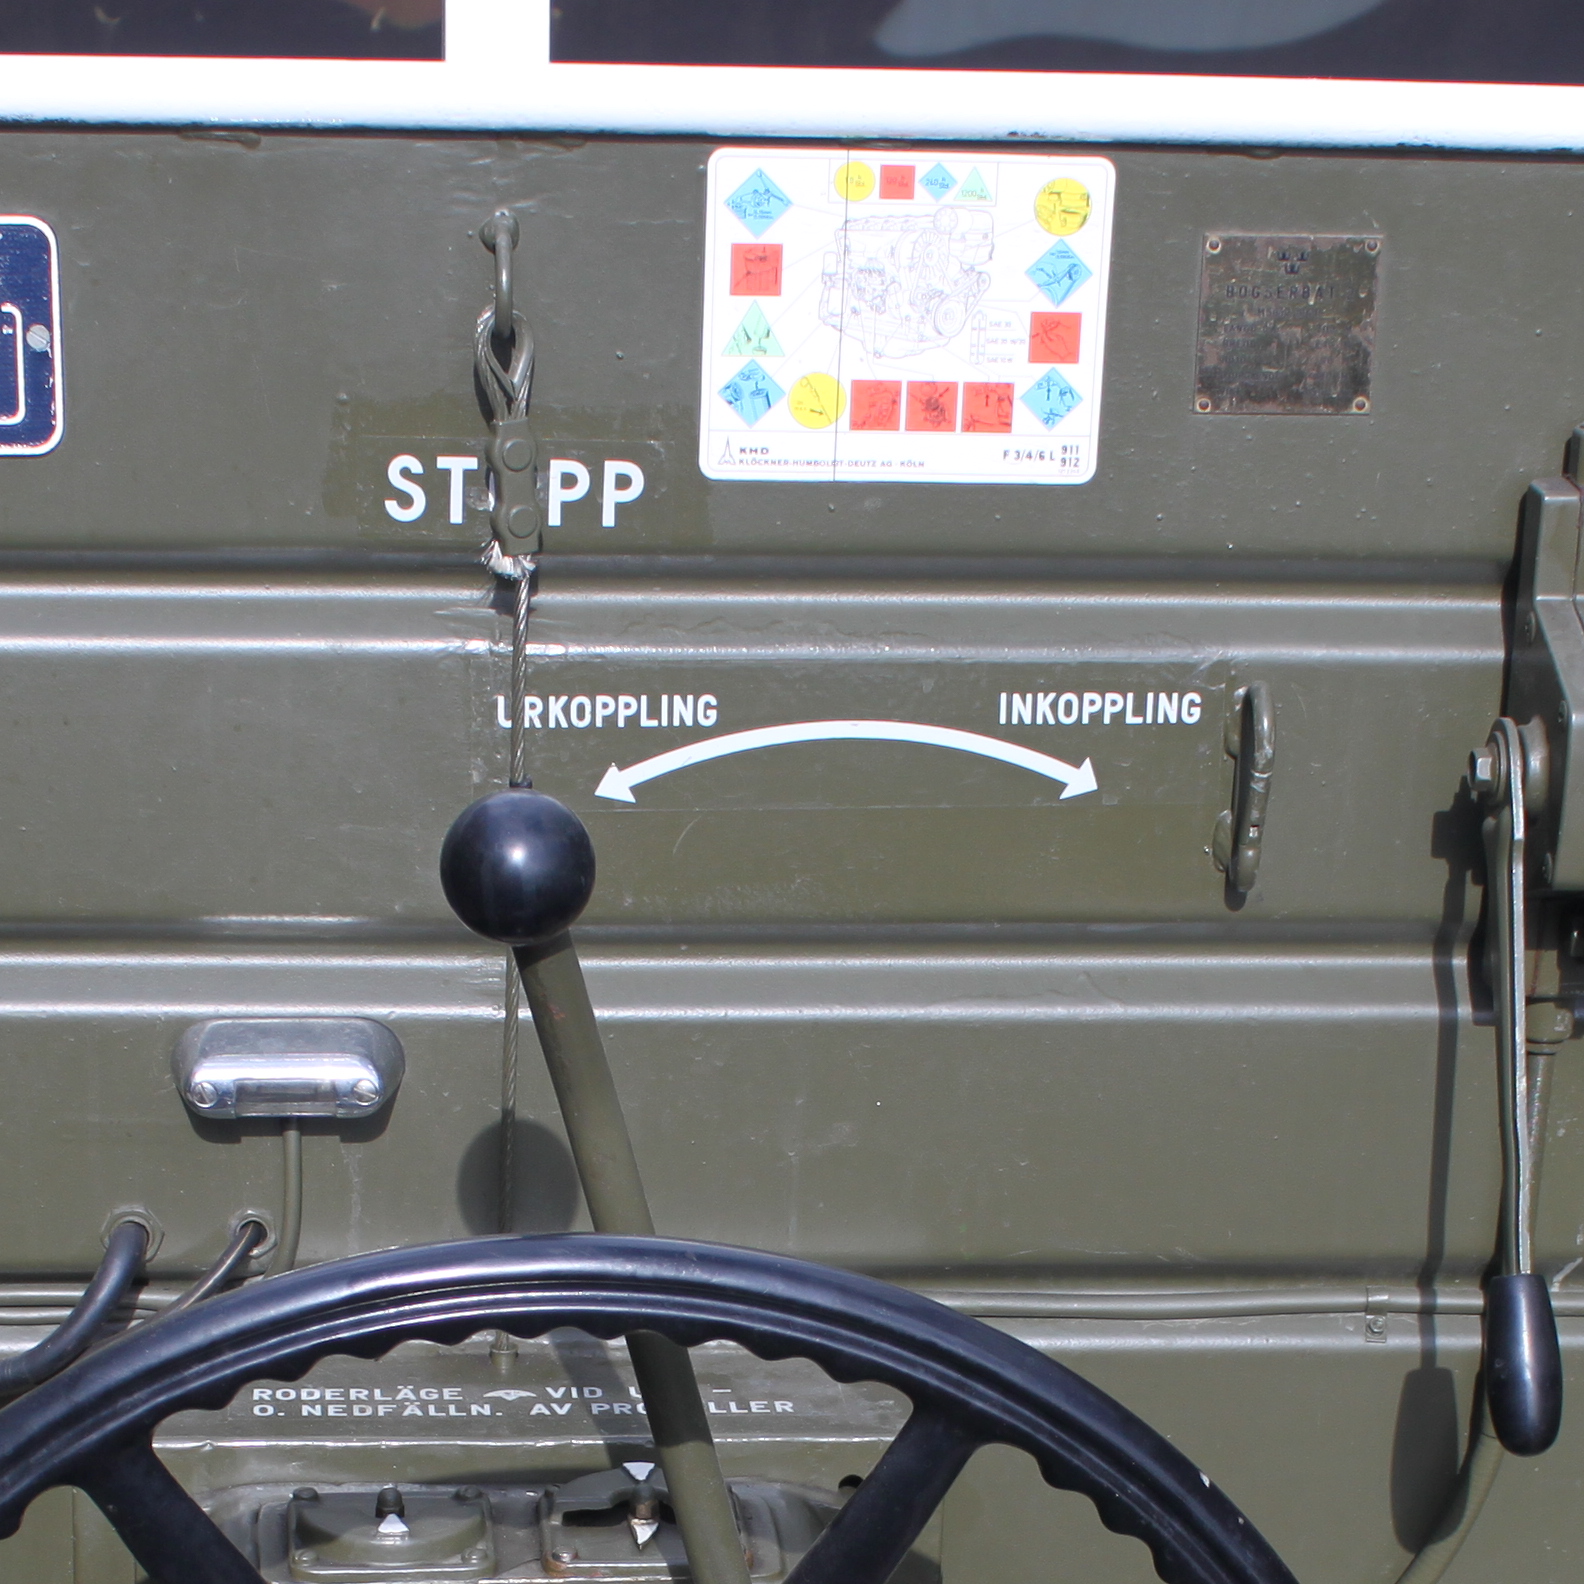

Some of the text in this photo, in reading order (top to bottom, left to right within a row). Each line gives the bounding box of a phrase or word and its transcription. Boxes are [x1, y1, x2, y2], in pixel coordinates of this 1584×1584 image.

[1003, 449, 1010, 461] F
[1014, 449, 1045, 462] 3/4/6
[1061, 444, 1080, 455] 911
[1060, 457, 1080, 468] 912
[384, 454, 645, 527] STPP
[999, 692, 1202, 725] INKOPPLING
[252, 1385, 463, 1401] RODERLÄGE
[545, 1386, 603, 1399] VID
[252, 1400, 795, 1417] O. NEDFÄLLN. AV PRLLER
